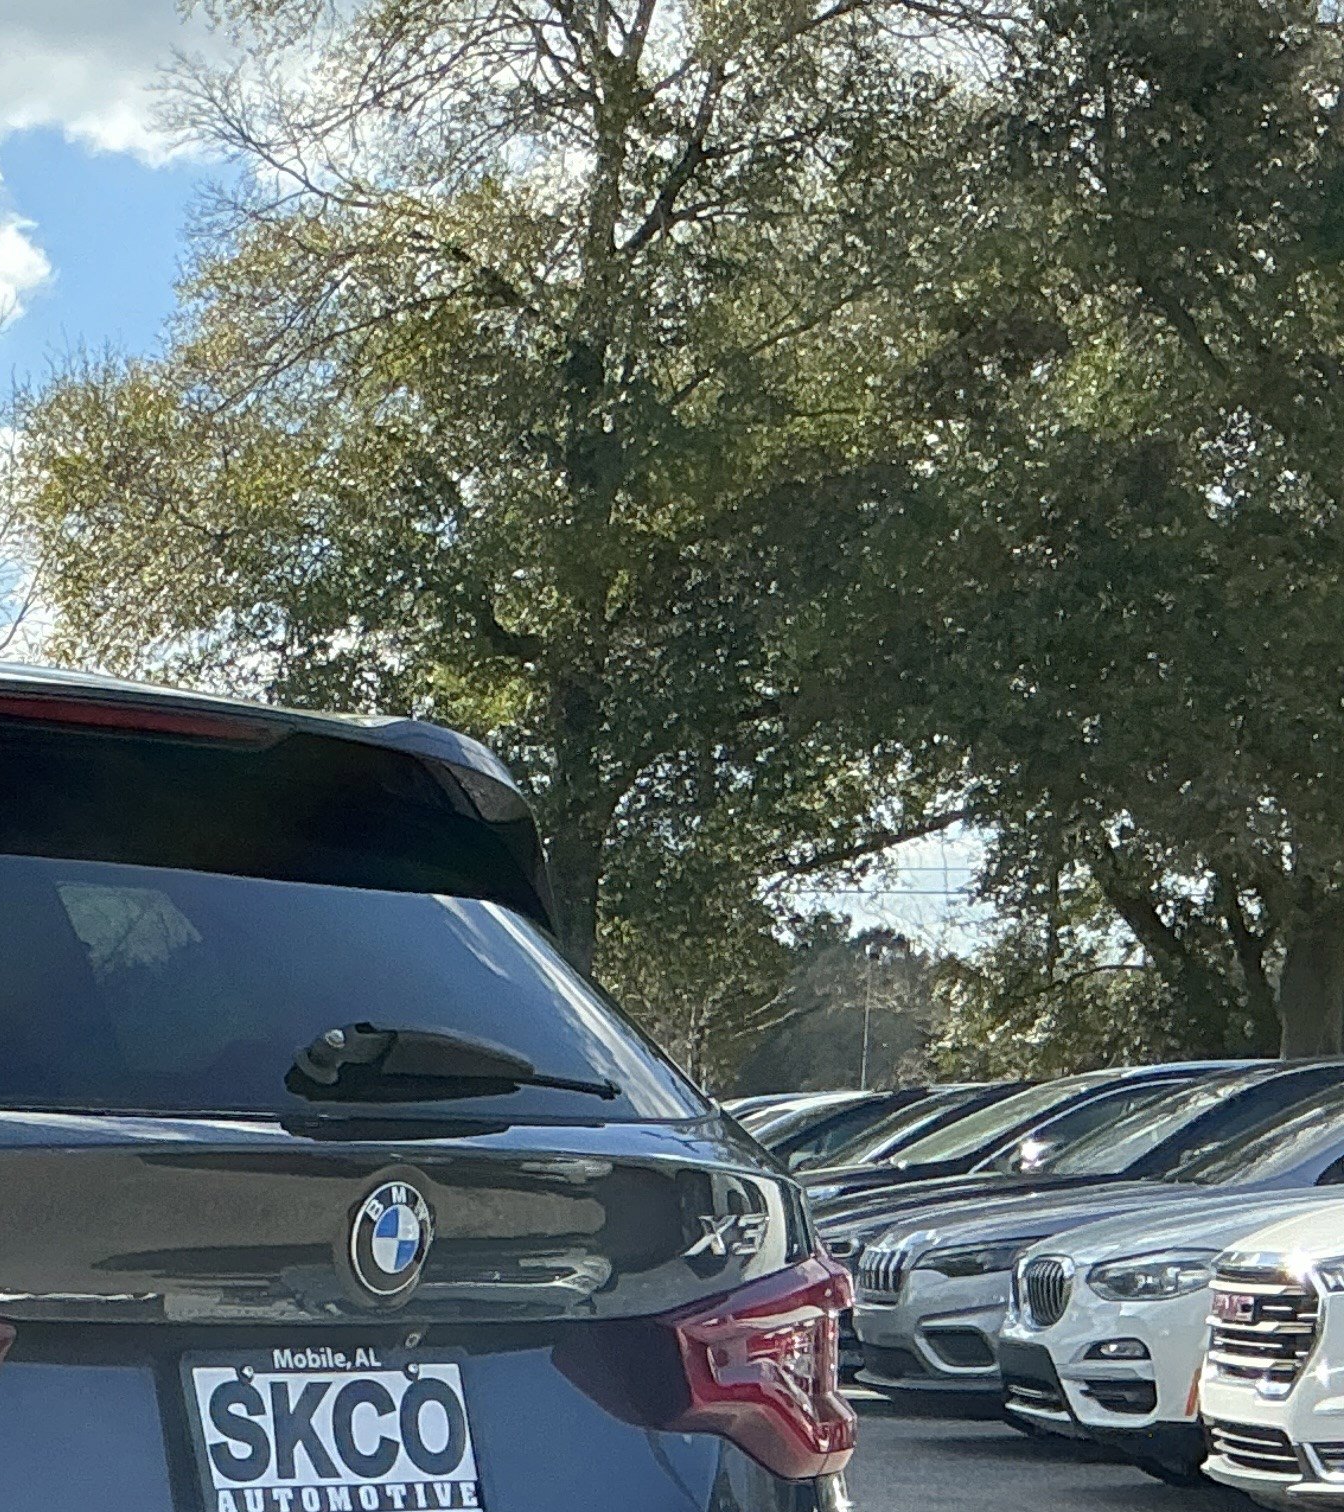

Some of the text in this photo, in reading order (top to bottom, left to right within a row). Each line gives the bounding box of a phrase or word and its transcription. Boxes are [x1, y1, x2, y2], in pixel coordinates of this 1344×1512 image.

[273, 1349, 382, 1370] Mobile, AL
[209, 1377, 466, 1482] SKCO
